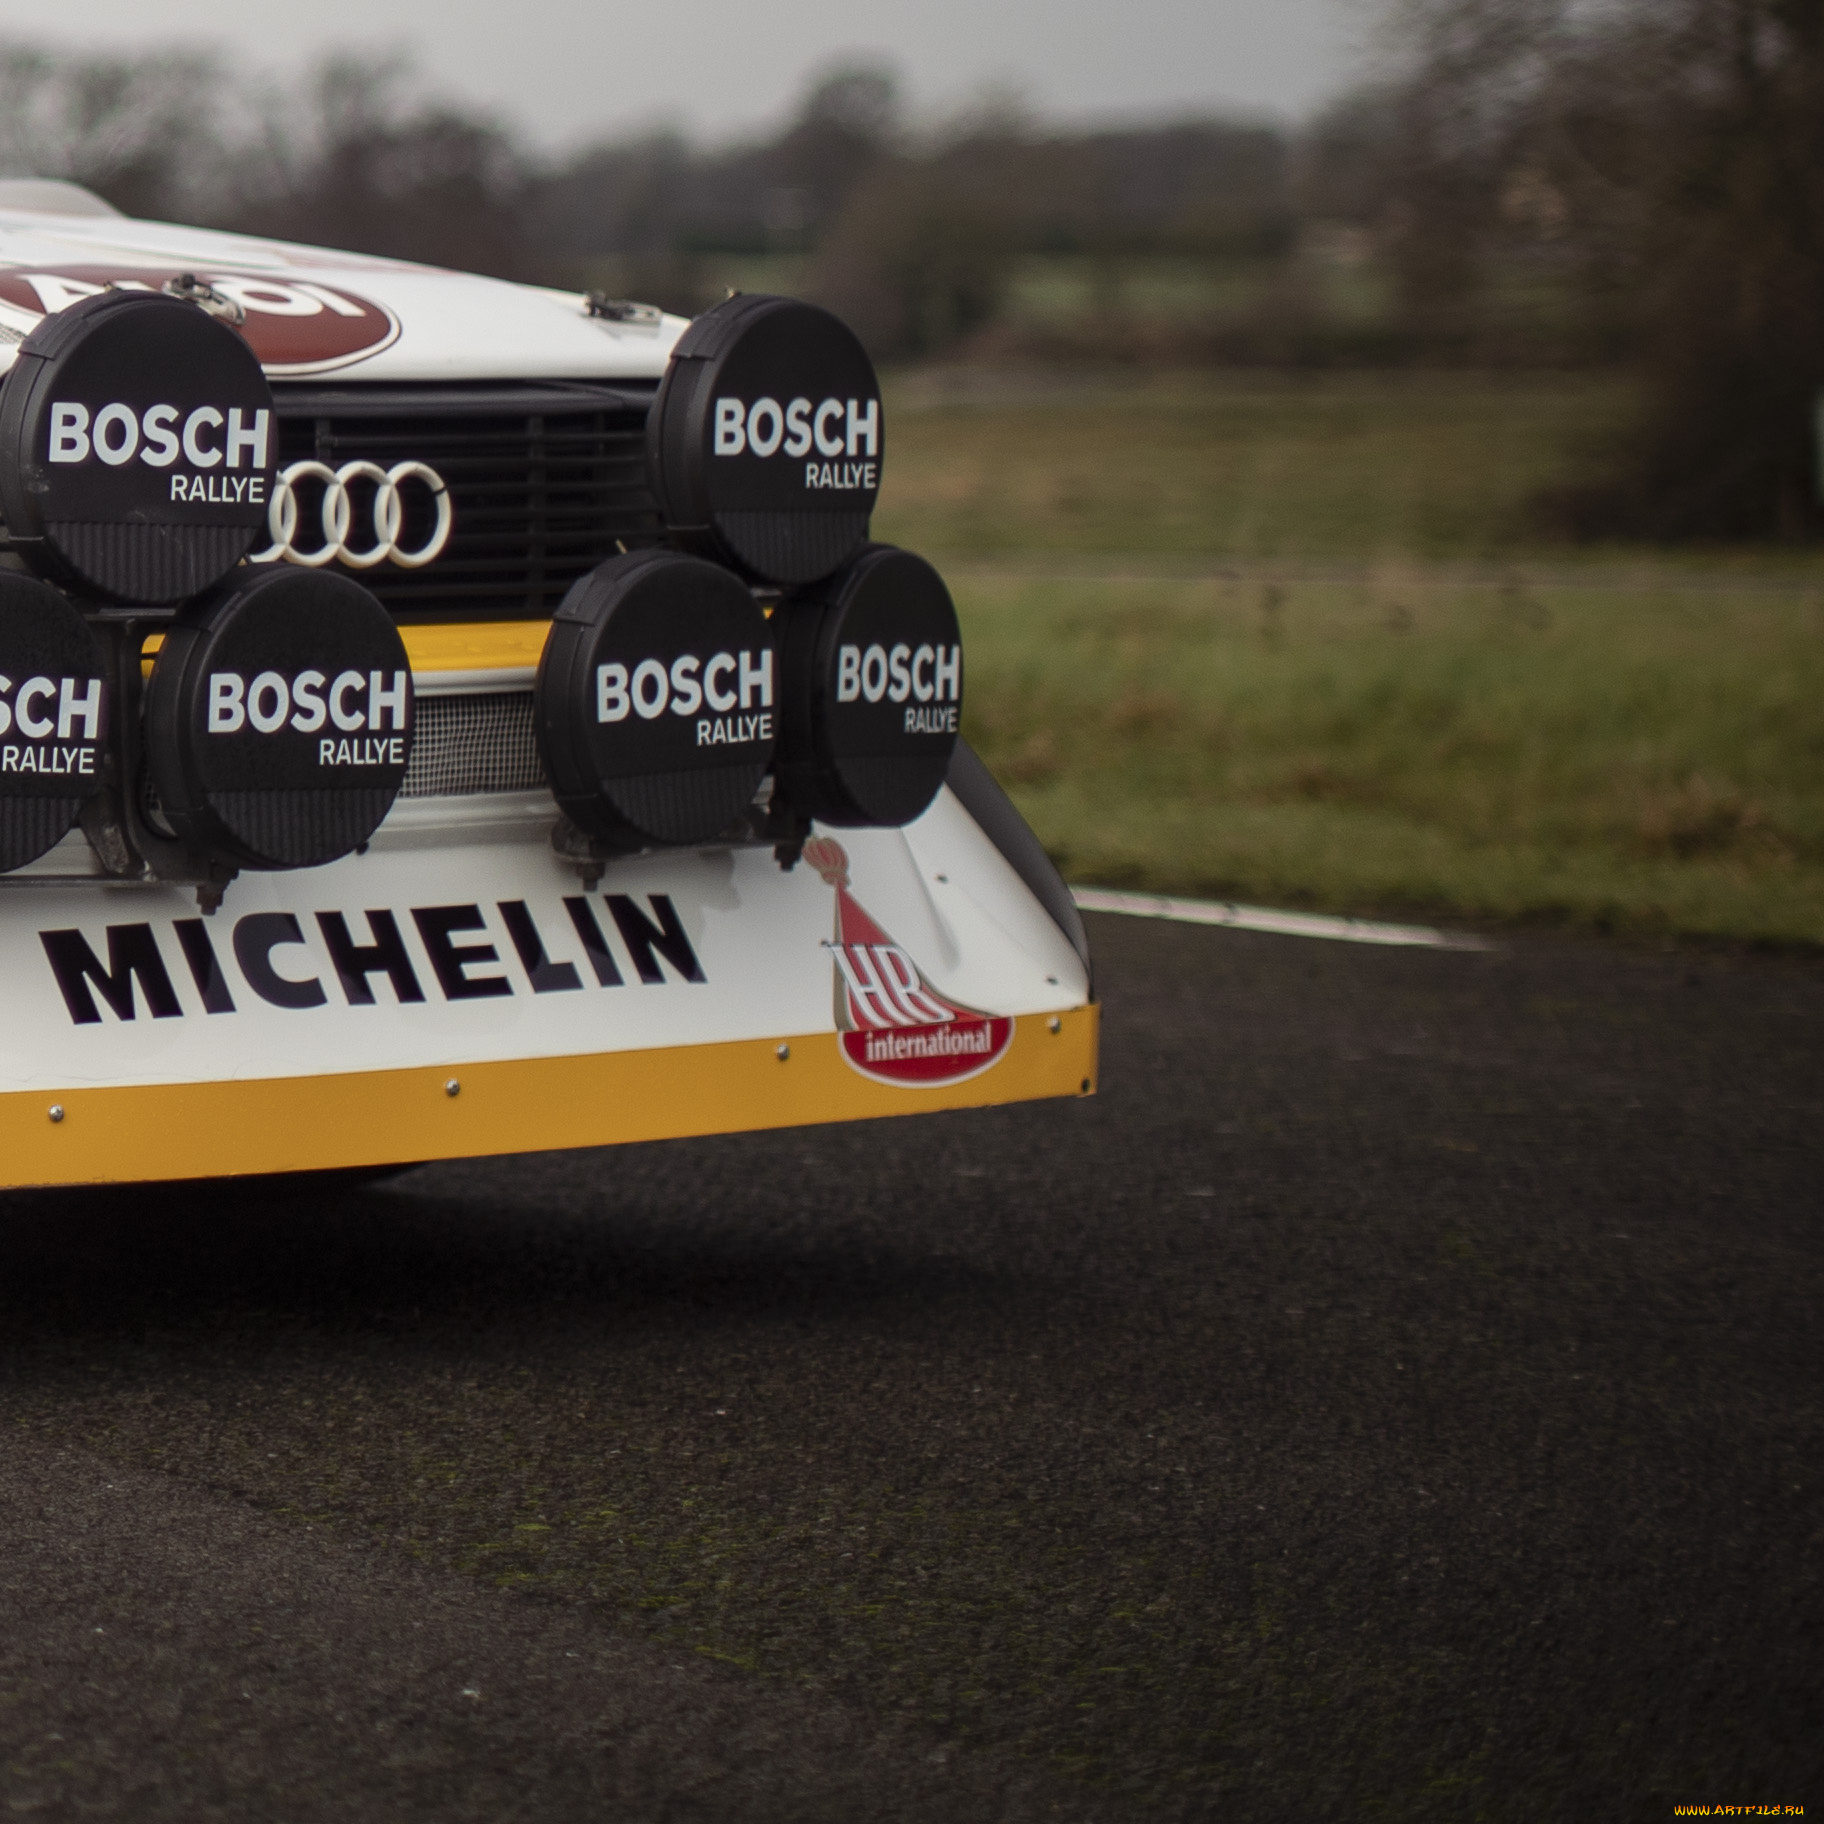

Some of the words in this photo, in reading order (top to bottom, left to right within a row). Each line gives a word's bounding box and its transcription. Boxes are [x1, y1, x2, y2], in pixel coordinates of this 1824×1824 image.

[16, 276, 367, 318] ADI
[49, 401, 270, 469] BOSCH
[714, 397, 878, 457] BOSCH
[170, 474, 265, 504] RALLYE
[805, 462, 876, 490] RALLYE
[598, 649, 773, 722] BOSCH
[837, 643, 960, 703] BOSCH
[208, 670, 407, 733] BOSCH
[903, 706, 958, 733] RALLYE
[696, 713, 772, 746] RALLYE
[1, 745, 96, 775] RALLYE
[319, 737, 405, 766] RALLYE
[37, 892, 709, 1026] MICHELIN
[865, 1021, 994, 1064] international
